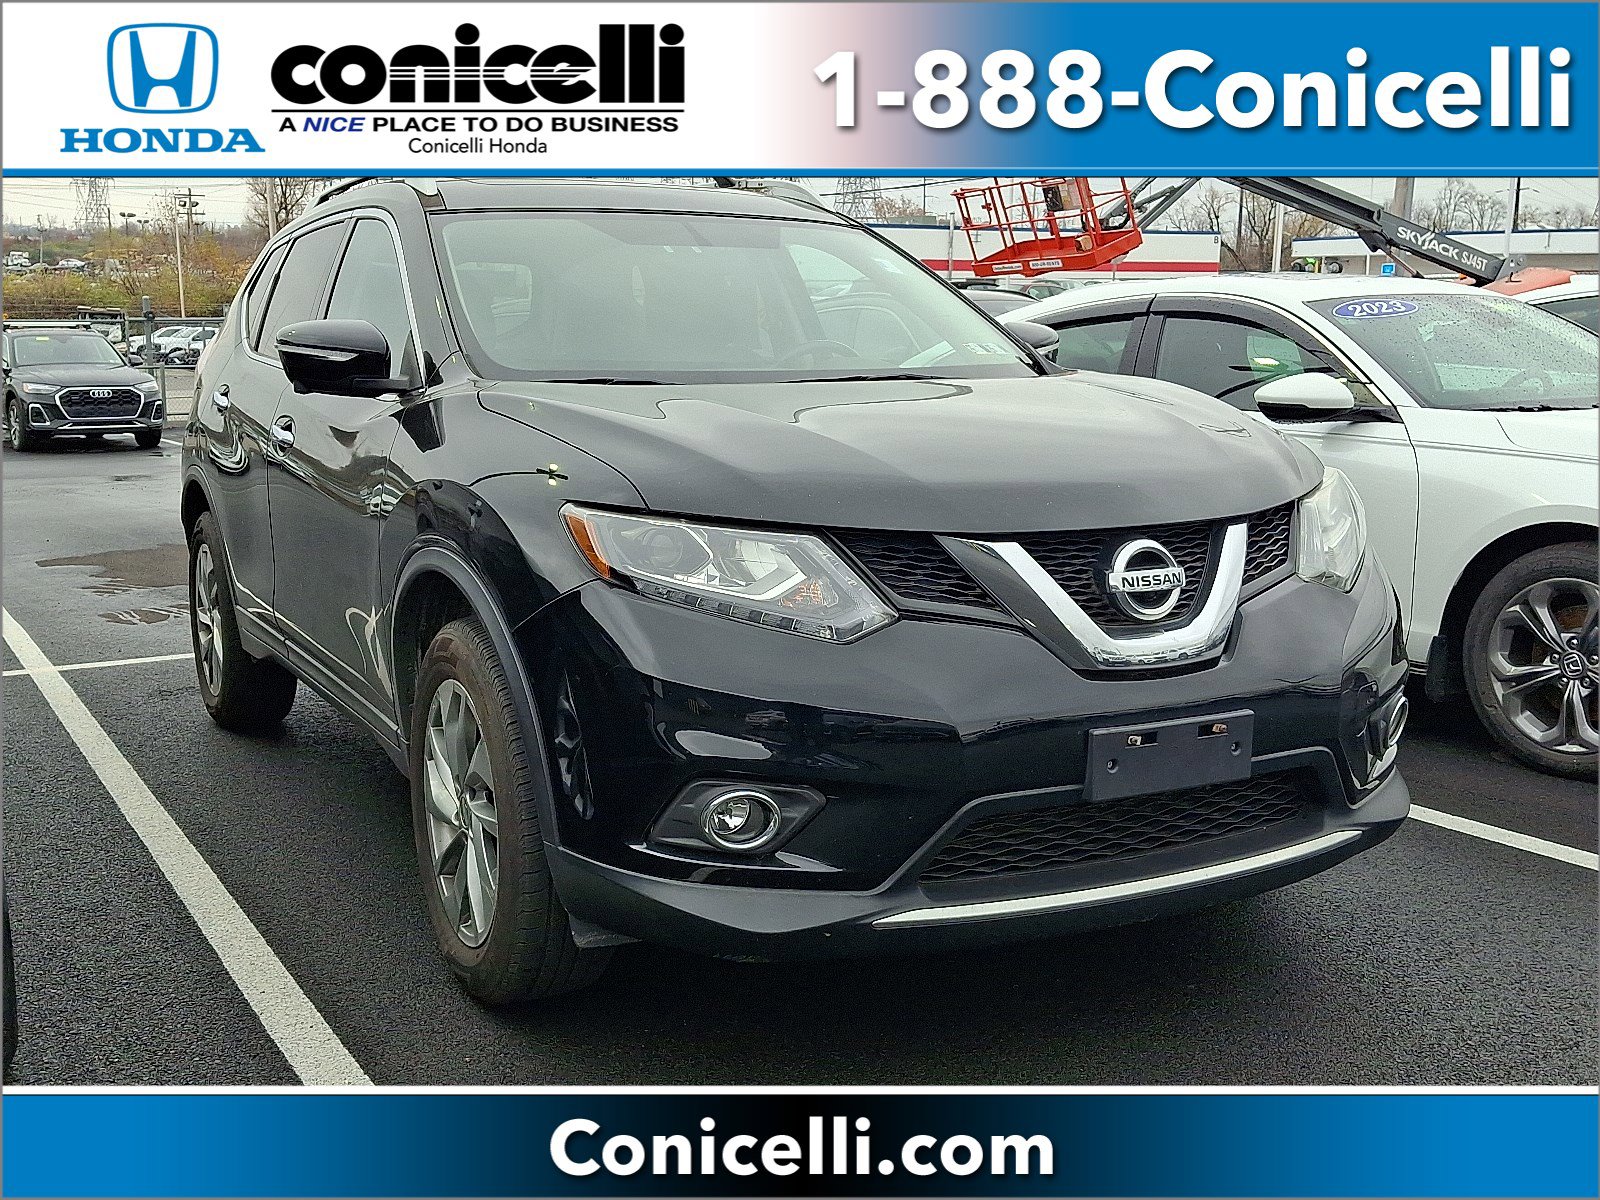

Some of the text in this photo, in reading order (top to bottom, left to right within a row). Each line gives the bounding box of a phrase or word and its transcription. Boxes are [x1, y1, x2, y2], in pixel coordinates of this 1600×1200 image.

[1397, 226, 1488, 271] SKYJACK SJ45T
[1347, 301, 1406, 317] 2023
[1121, 572, 1182, 588] NISSAN
